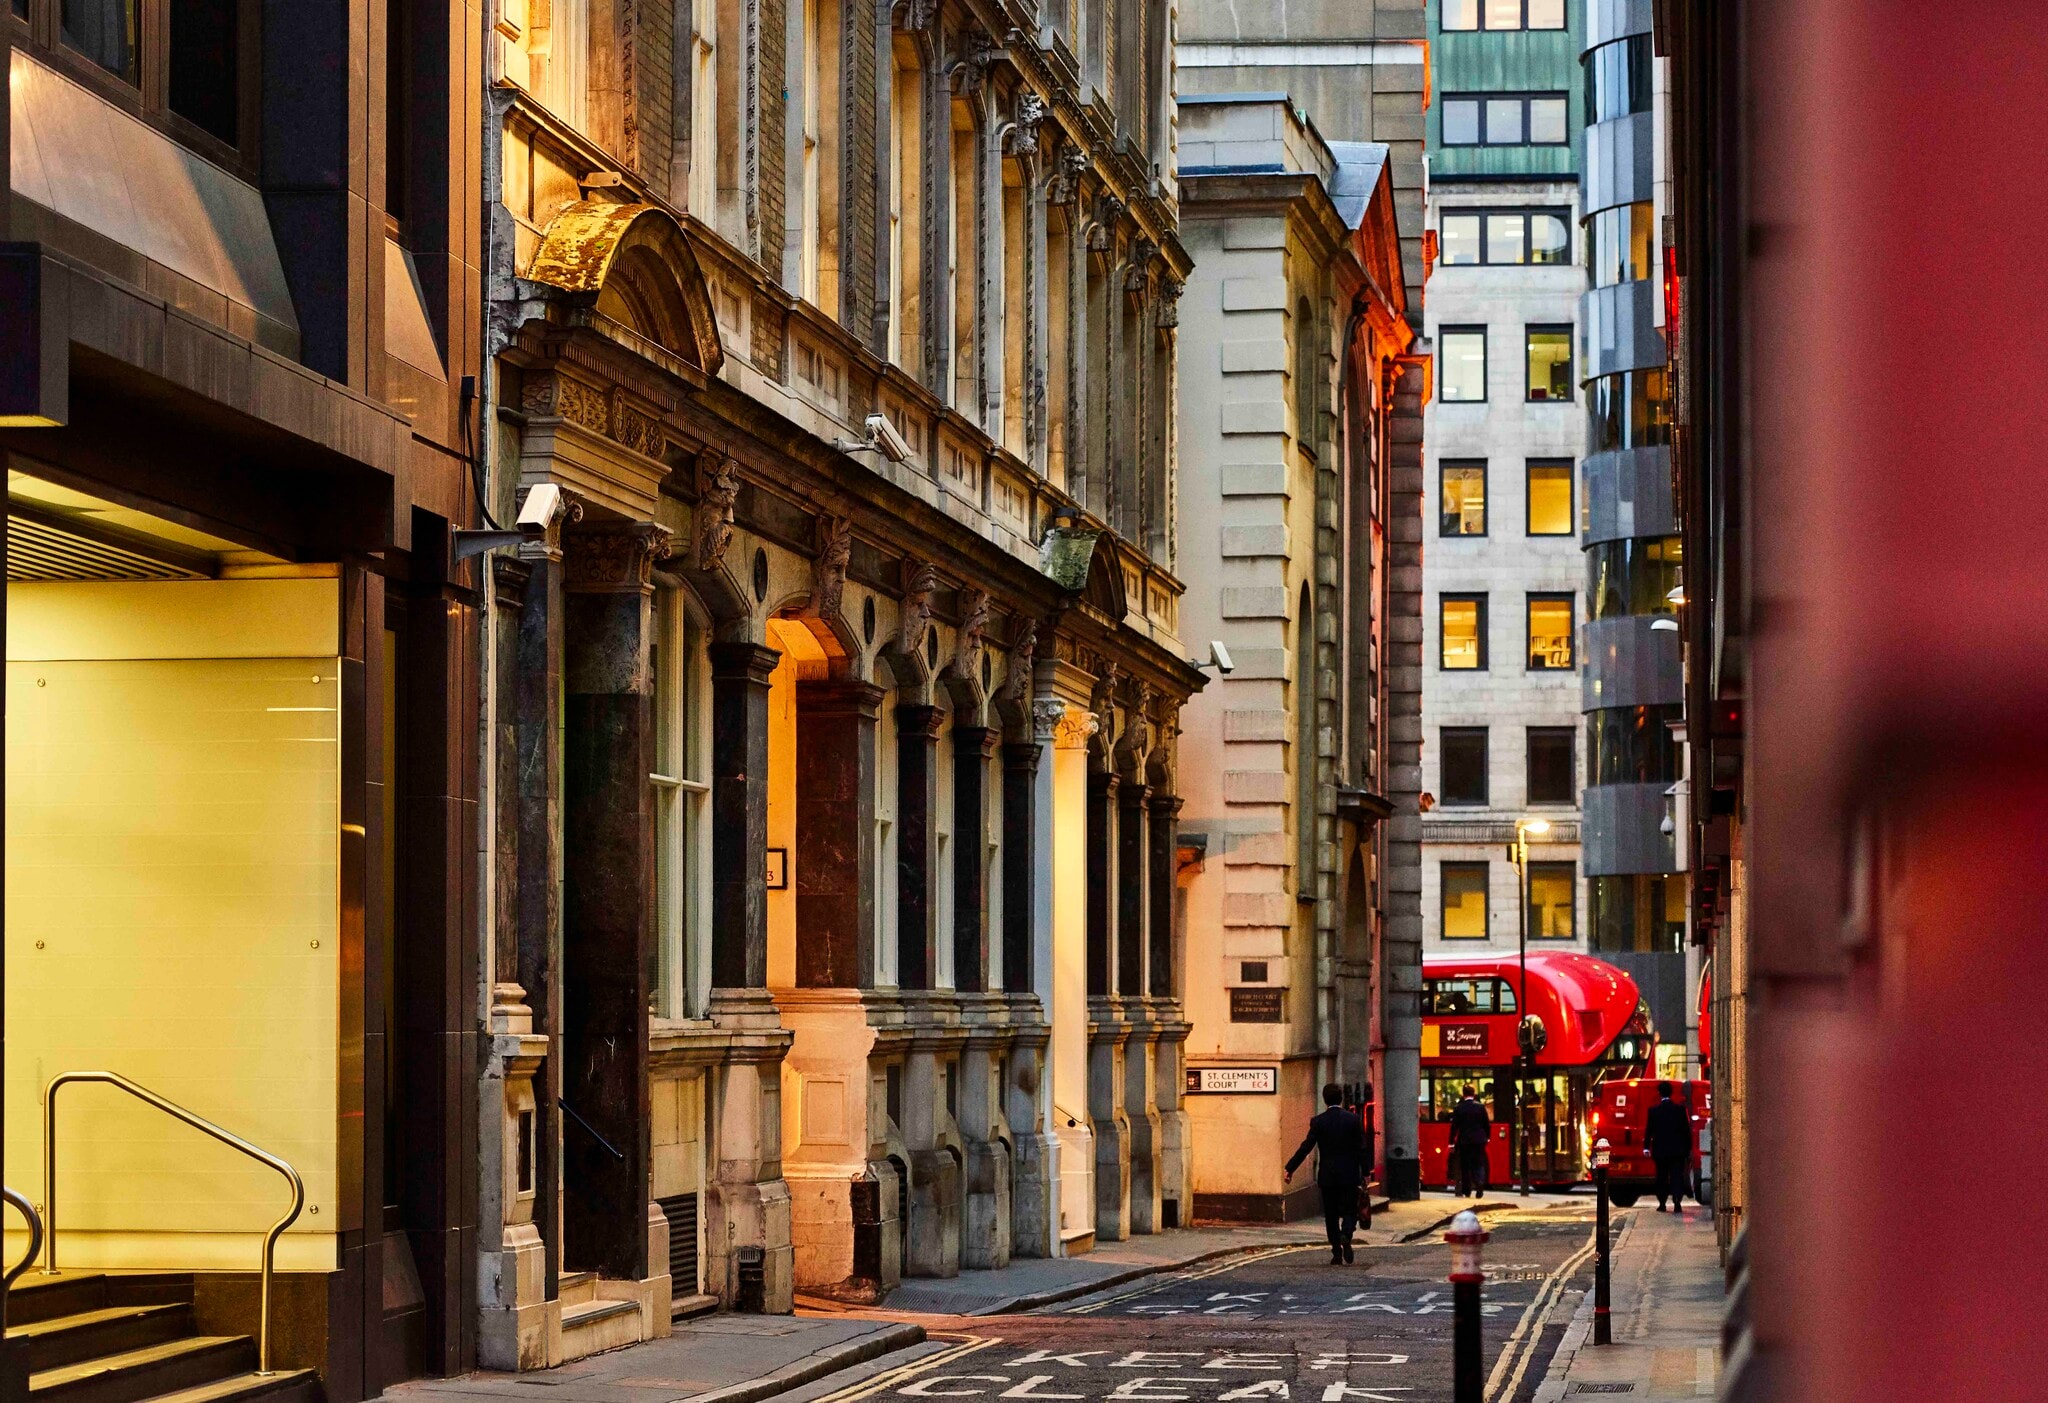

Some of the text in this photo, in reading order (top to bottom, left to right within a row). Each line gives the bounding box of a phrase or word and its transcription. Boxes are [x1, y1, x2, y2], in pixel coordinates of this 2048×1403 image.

[1207, 1072, 1269, 1080] ST. CLEMENT'S
[1207, 1081, 1238, 1089] COURT
[1252, 1081, 1269, 1089] EC4
[1001, 1349, 1409, 1369] KEEP
